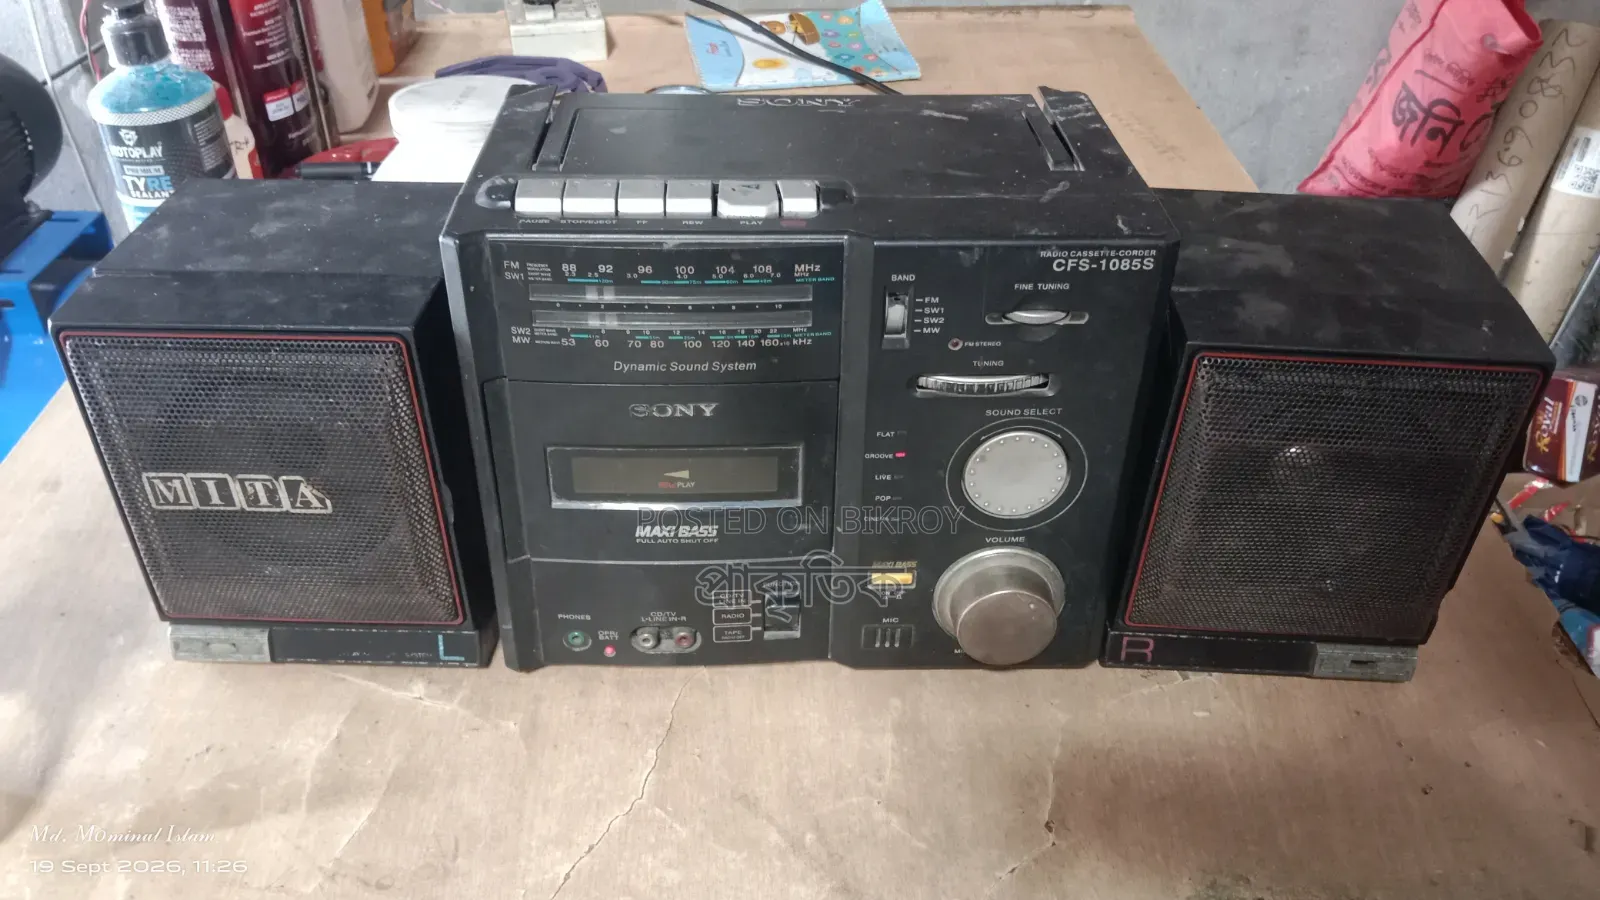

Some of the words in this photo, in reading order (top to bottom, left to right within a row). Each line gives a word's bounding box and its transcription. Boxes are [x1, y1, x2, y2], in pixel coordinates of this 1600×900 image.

[737, 97, 861, 107] SONY
[122, 175, 174, 192] TYRE
[1040, 250, 1068, 258] RADIO
[1070, 249, 1157, 258] CASSETTE-CORDER
[503, 260, 520, 270] FM
[561, 263, 577, 272] 88
[598, 264, 614, 273] 92
[637, 265, 653, 274] 96
[674, 266, 695, 275] 100
[715, 265, 735, 275] 104
[752, 265, 773, 274] 108
[793, 263, 821, 273] MHz
[1052, 258, 1155, 272] CFS-1085S
[504, 271, 525, 281] SW1
[891, 274, 916, 282] BAND
[1014, 283, 1034, 291] FINE
[1037, 283, 1070, 291] TUNING
[510, 326, 531, 335] SW2
[512, 336, 531, 344] MW
[561, 338, 576, 346] 53
[594, 339, 610, 348] 60
[627, 340, 642, 348] 70
[650, 340, 665, 348] 80
[683, 340, 703, 348] 100
[711, 340, 731, 348] 120
[760, 339, 779, 347] 160
[792, 338, 813, 346] kHz
[613, 360, 667, 373] Dynamic
[669, 361, 709, 372] Sound
[711, 361, 757, 373] System
[628, 403, 719, 418] SONY
[1023, 408, 1063, 416] SELECT
[146, 475, 329, 512] MITA
[635, 525, 676, 538] MAXI
[678, 525, 719, 538] BASS
[985, 536, 1026, 544] VOLUME
[557, 613, 592, 621] PHONES
[437, 633, 466, 661] L
[1120, 636, 1155, 662] R
